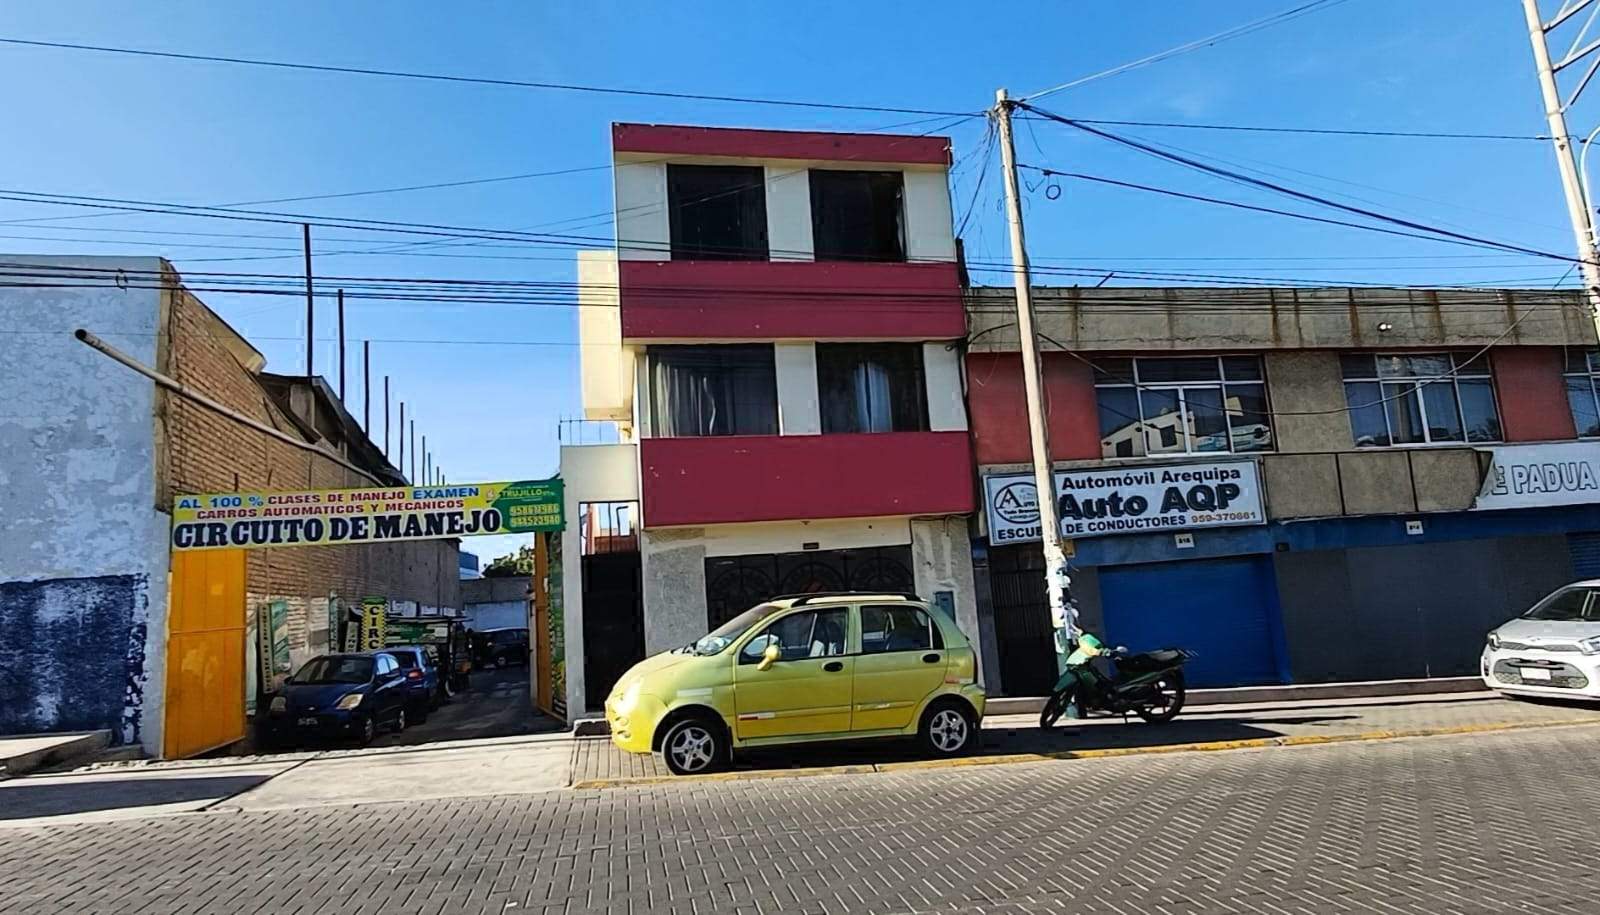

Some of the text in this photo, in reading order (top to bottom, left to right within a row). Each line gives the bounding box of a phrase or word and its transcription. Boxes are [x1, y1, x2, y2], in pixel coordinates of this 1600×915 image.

[1062, 467, 1241, 490] Automóvil Arequipa
[1512, 461, 1597, 495] PADUA
[179, 498, 201, 509] AL
[210, 497, 242, 508] 100
[268, 494, 321, 505] CLASES
[327, 493, 344, 502] DE
[350, 491, 405, 502] MANEJO
[412, 488, 479, 500] EXAMEN
[197, 500, 464, 520] CARROS AUTOMATICOS Y MECANICOS
[1059, 483, 1241, 523] Auto AQP
[174, 509, 501, 548] CIRCUITO DE MANEJO
[997, 526, 1043, 540] ESCUE
[1066, 523, 1085, 534] DE
[1087, 515, 1186, 532] CONDUCTORES
[368, 606, 380, 650] CIRC
